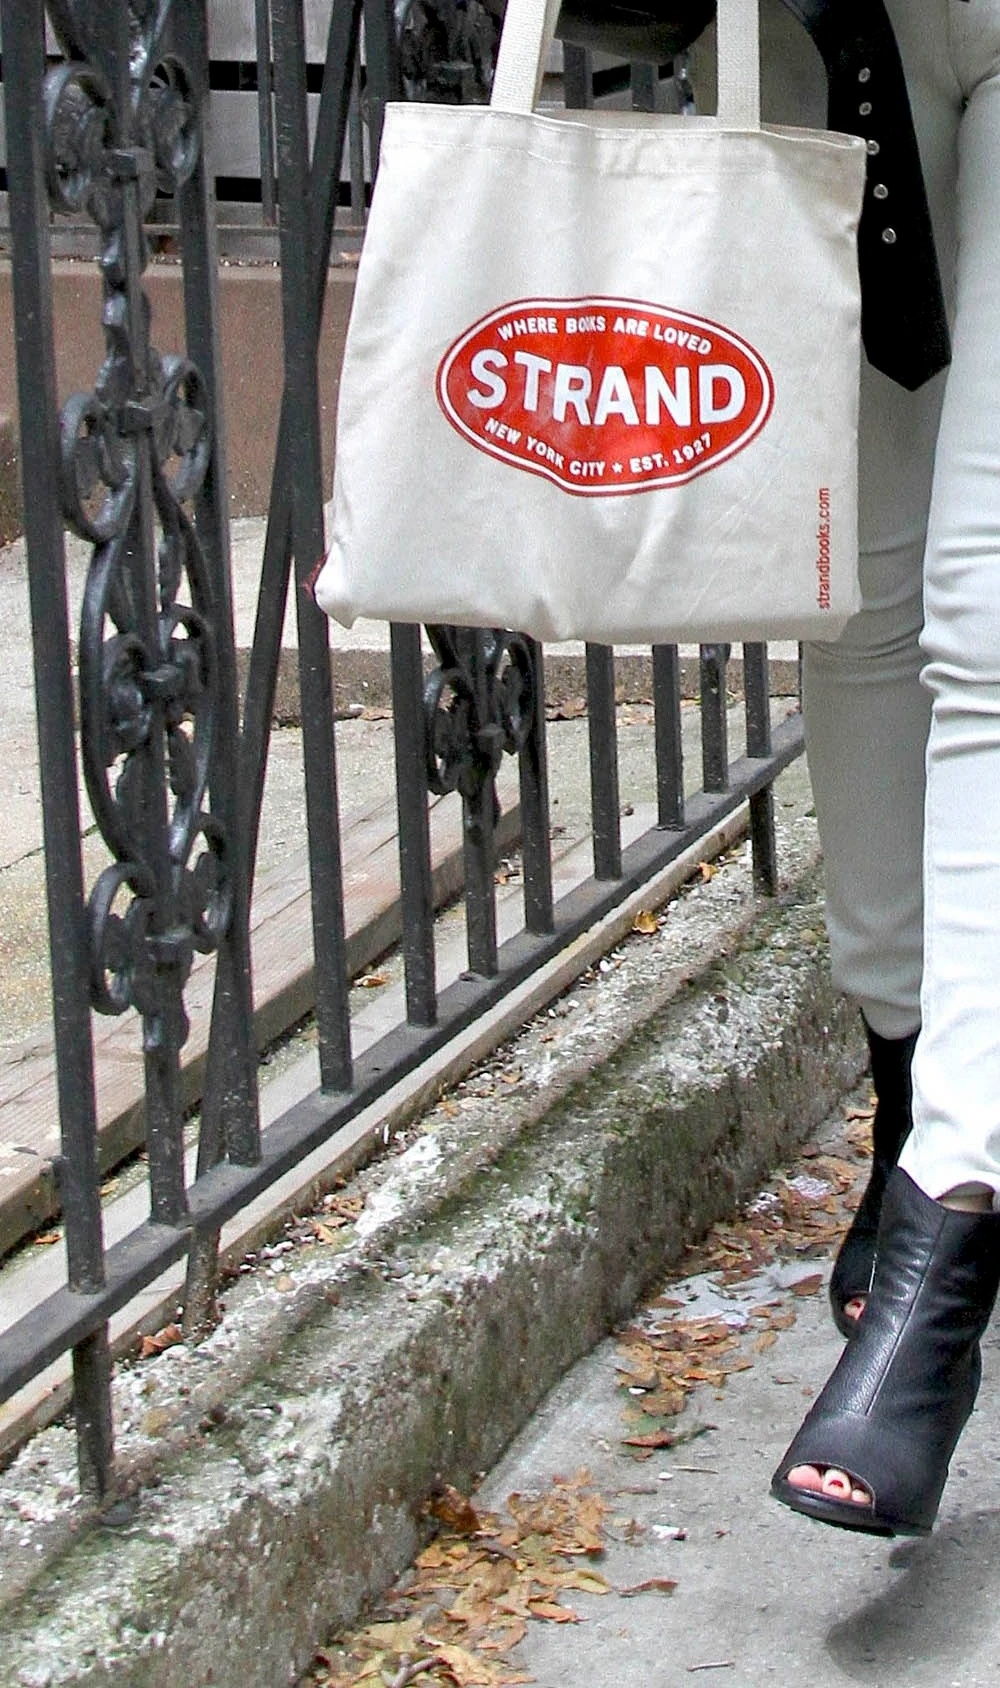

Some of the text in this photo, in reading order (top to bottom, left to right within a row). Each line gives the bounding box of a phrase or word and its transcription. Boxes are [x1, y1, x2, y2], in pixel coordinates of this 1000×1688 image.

[498, 317, 557, 341] WHERE
[613, 317, 650, 337] ARE
[653, 324, 712, 355] LOVED
[466, 348, 747, 427] STRAND
[484, 417, 712, 476] NEW YORK CITY EST. 1927
[817, 487, 830, 610] strandbooks.com
